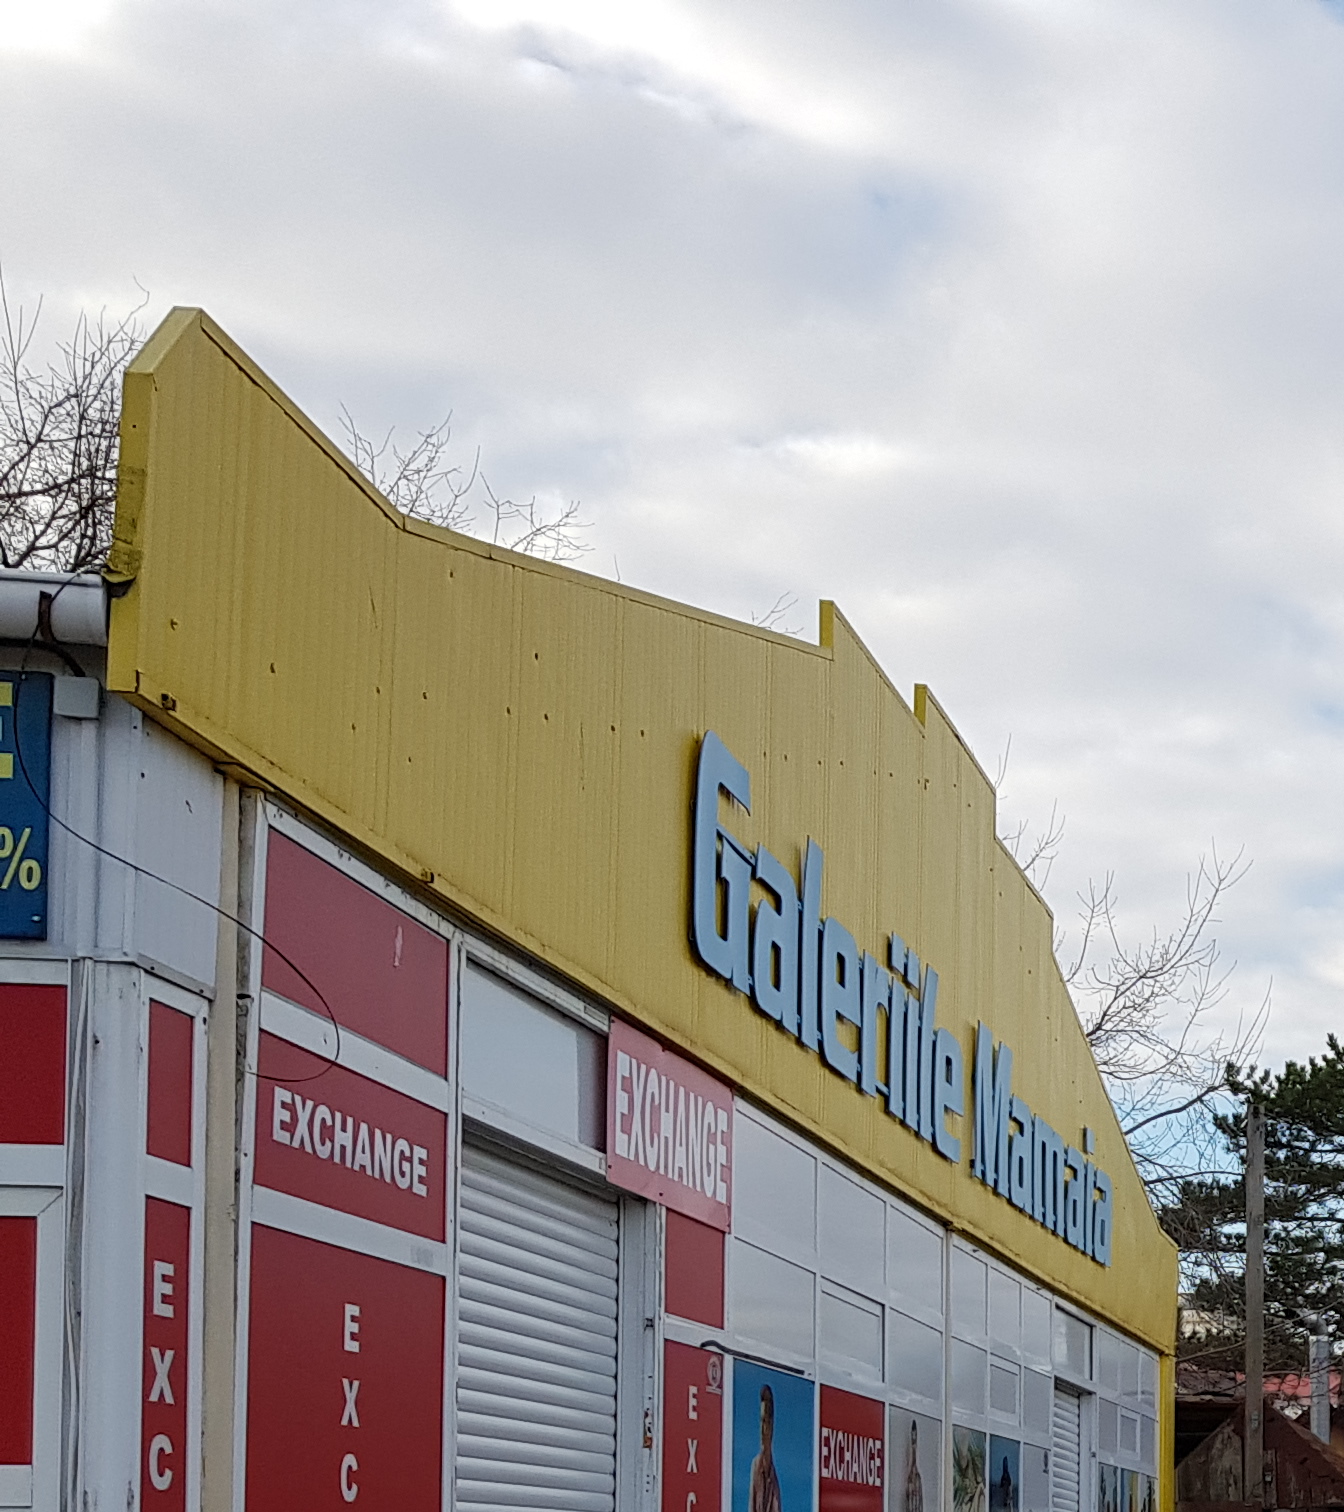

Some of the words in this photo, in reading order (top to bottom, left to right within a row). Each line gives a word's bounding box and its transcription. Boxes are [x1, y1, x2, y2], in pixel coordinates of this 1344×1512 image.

[694, 730, 964, 1164] Galeriile
[973, 1020, 1112, 1267] Mamaia
[270, 1085, 429, 1198] EXCHANGE
[614, 1048, 728, 1205] EXCHANGE
[821, 1426, 882, 1487] EXCHANGE
